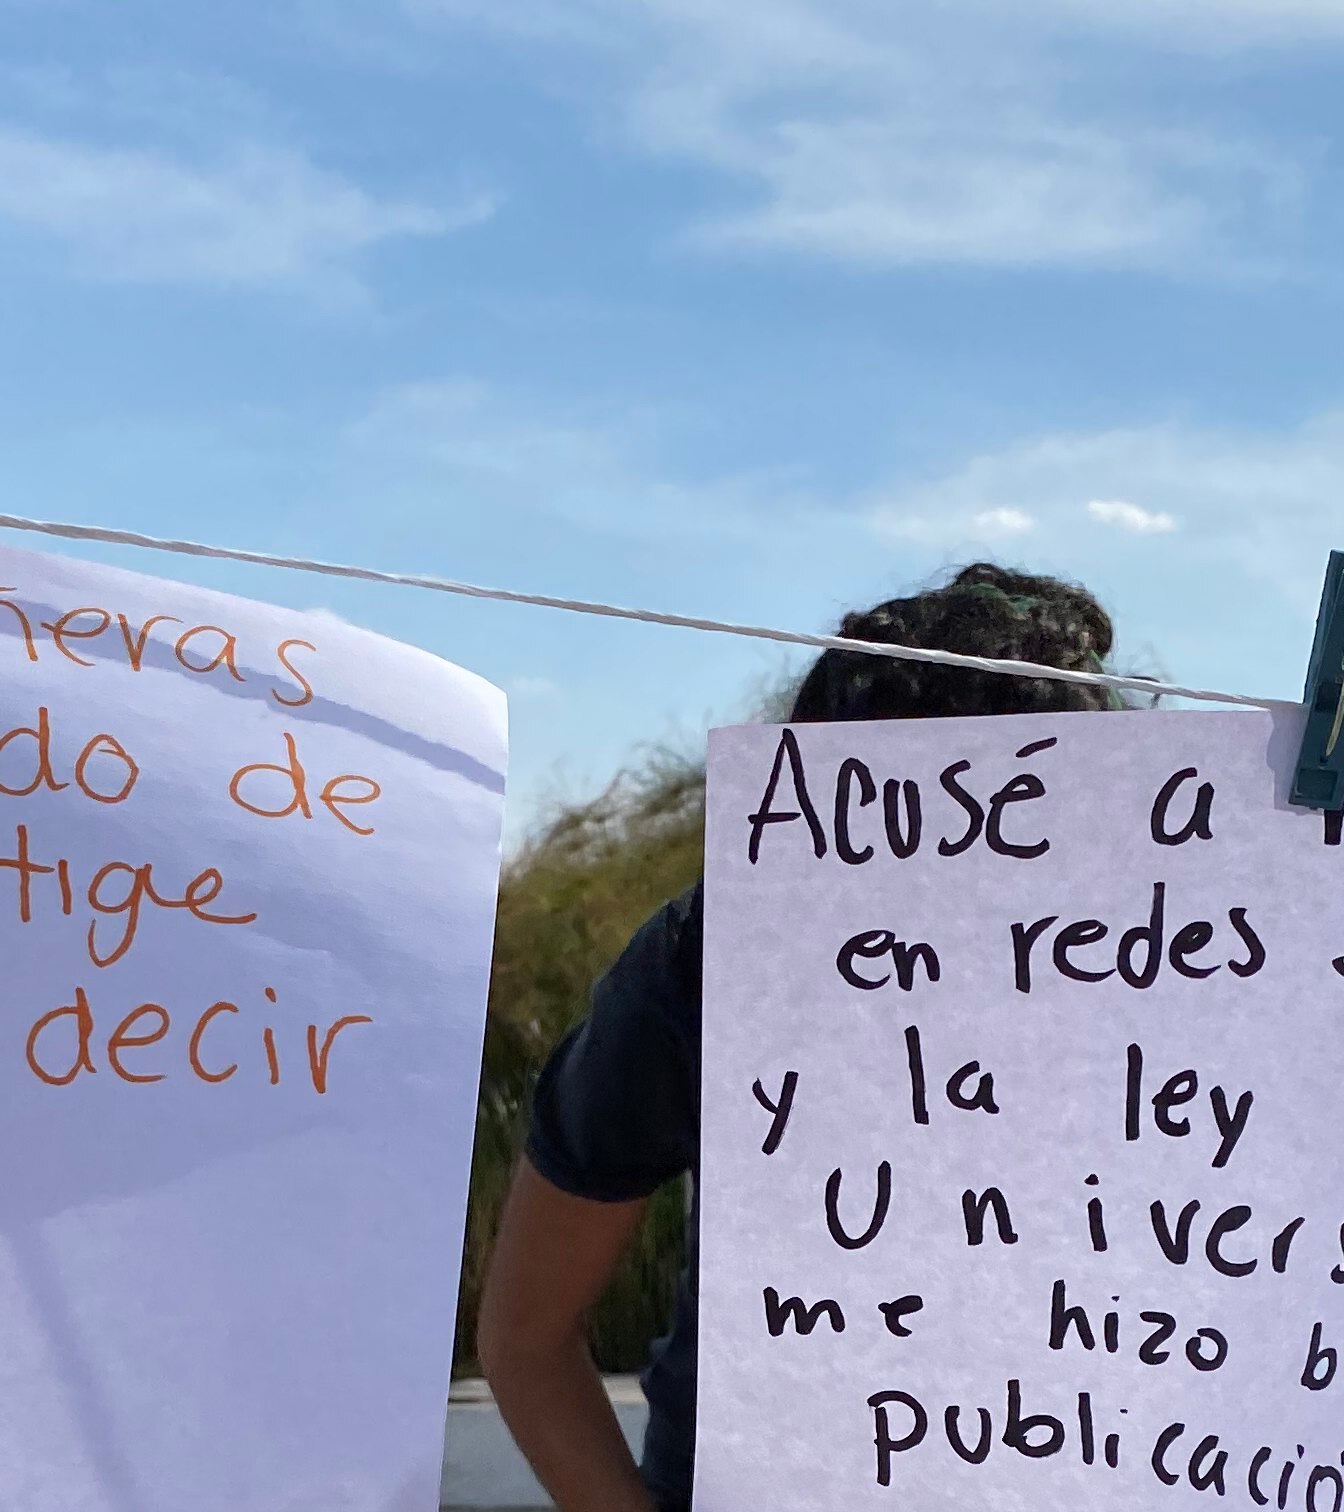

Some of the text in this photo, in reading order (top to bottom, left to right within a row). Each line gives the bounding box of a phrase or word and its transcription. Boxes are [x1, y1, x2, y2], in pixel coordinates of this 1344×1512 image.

[228, 732, 381, 835] de
[747, 728, 1058, 866] Acusé
[1150, 766, 1215, 847] a
[835, 929, 941, 992] en
[1009, 881, 1267, 994] redes
[25, 986, 374, 1095] decir
[751, 1070, 799, 1155] y
[903, 1024, 1000, 1126] la
[1125, 1042, 1255, 1168] ley
[762, 1284, 925, 1337] me
[1048, 1278, 1229, 1372] hizo
